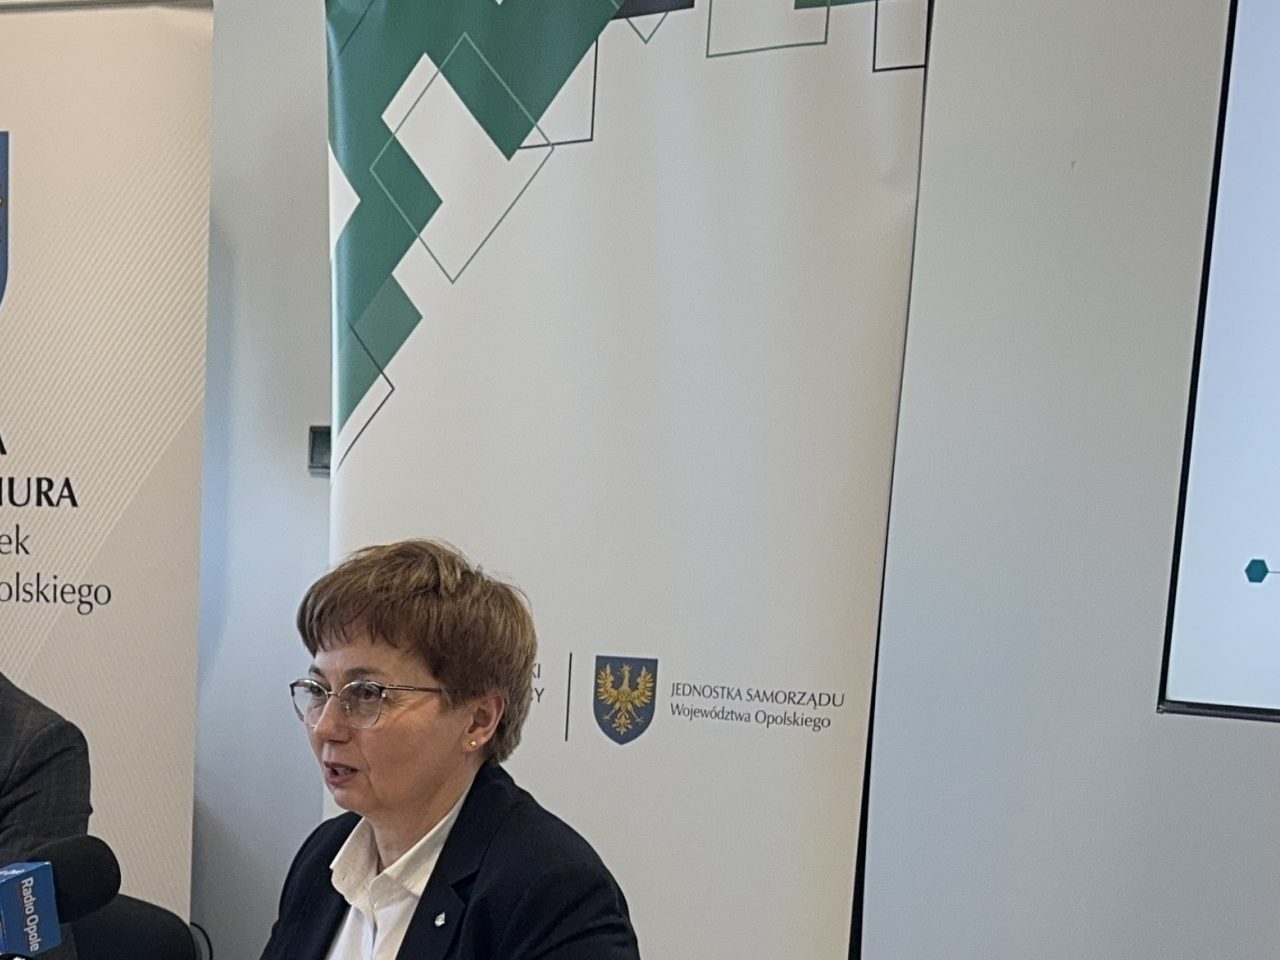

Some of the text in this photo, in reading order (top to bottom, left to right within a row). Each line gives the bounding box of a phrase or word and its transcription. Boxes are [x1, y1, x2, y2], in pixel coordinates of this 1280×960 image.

[670, 682, 845, 709] JEDNOSTKA SAMORZĄDU
[670, 703, 831, 732] Województwa Opolskiego
[21, 876, 42, 952] Radio Opole
